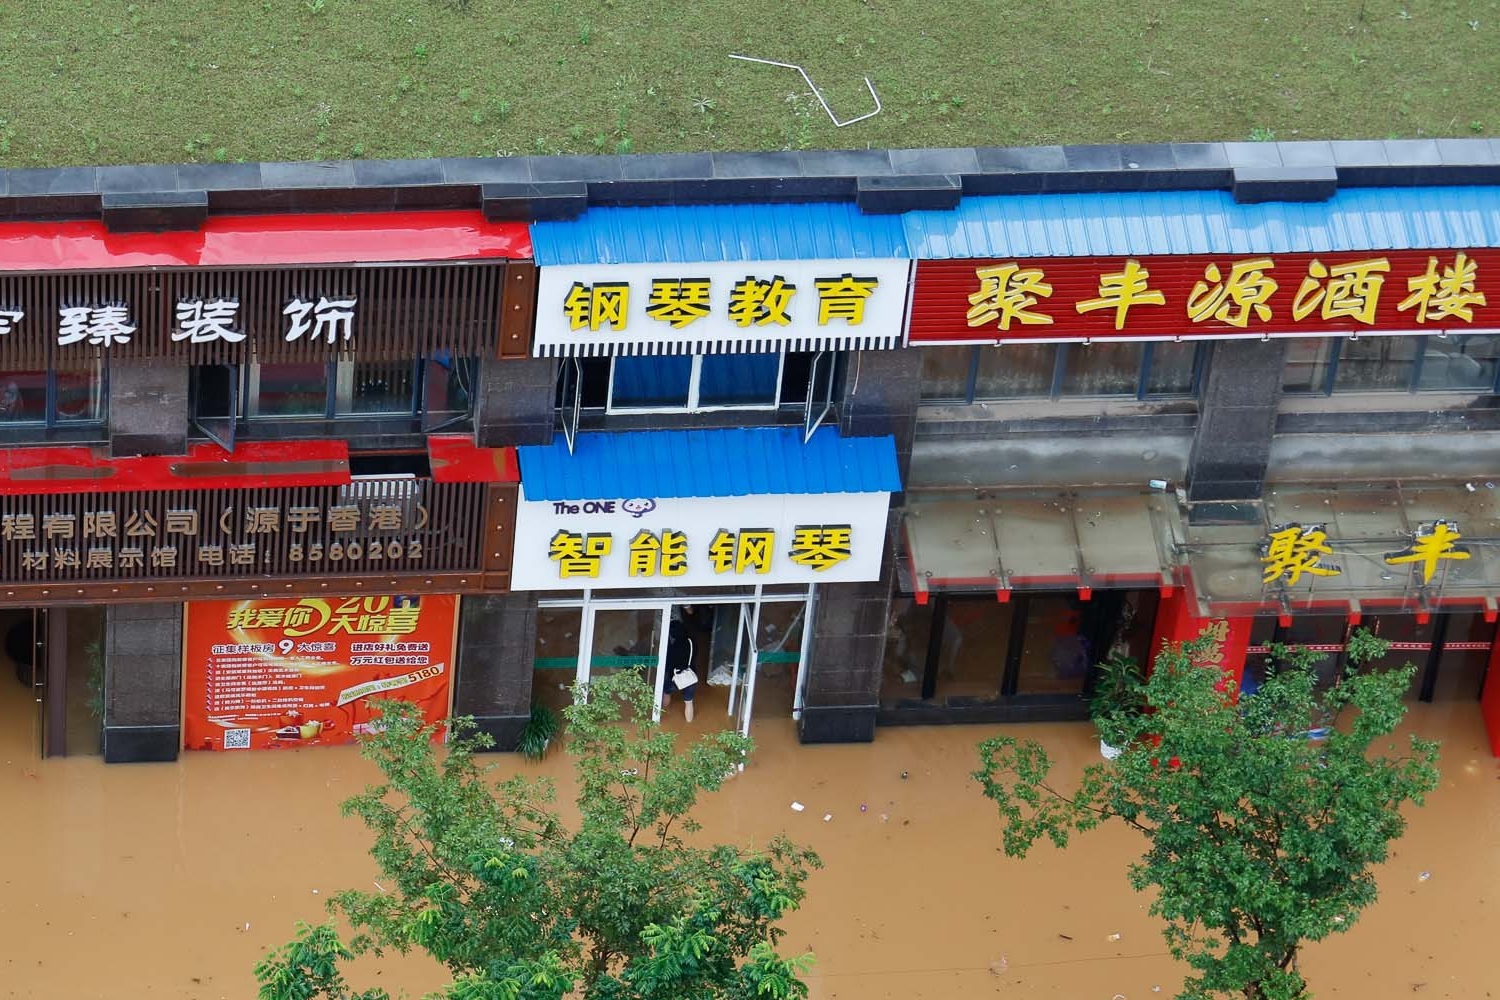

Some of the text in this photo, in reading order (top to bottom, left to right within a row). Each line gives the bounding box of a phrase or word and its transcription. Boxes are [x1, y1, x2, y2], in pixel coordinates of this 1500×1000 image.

[563, 272, 879, 331] 钢琴教育
[966, 252, 1487, 331] 聚丰源酒楼
[553, 501, 616, 515] The ONE
[21, 545, 179, 571] 材料展示馆
[547, 523, 853, 580] 智能钢琴
[1260, 521, 1472, 587] 聚丰
[227, 606, 314, 630] 我爱你
[327, 607, 421, 636] 大惊喜
[351, 642, 430, 652] 进店好礼免费送
[350, 655, 429, 666] 万元红包送给您
[407, 665, 441, 683] 5180
